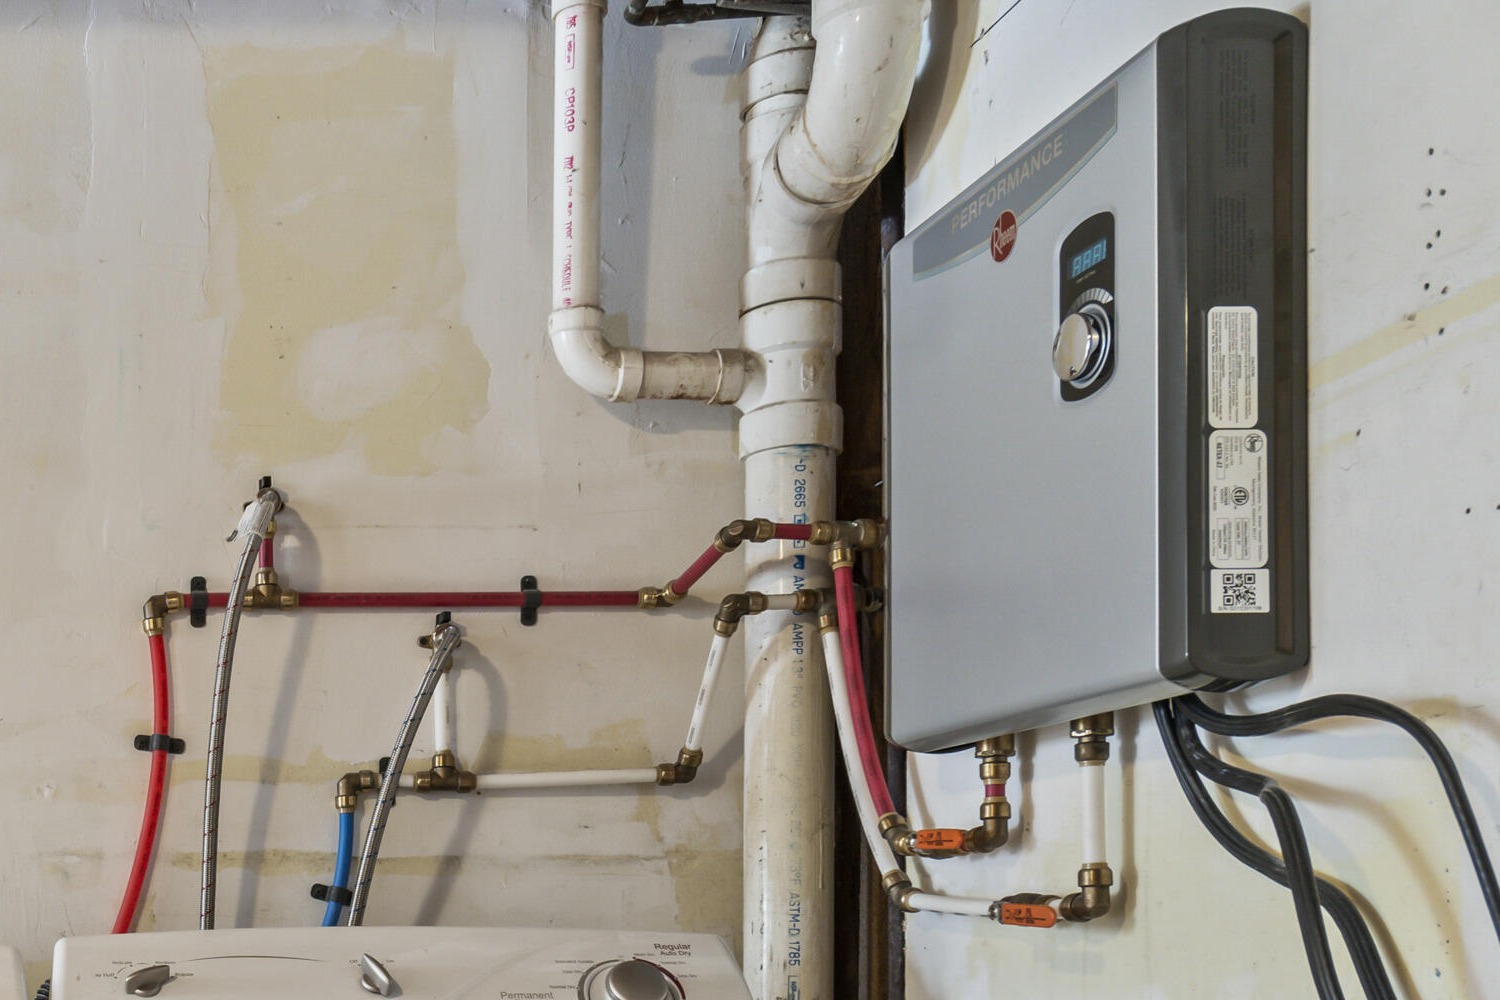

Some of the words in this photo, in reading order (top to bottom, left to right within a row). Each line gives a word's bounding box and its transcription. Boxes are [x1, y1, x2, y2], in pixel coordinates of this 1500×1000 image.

[951, 134, 1064, 237] PERFORMANCE
[993, 214, 1017, 257] Rheem
[794, 478, 807, 508] 2665
[792, 623, 805, 656] AMPP
[788, 892, 803, 938] ASTM-D
[654, 943, 692, 951] Regular
[788, 941, 802, 968] 1785
[500, 991, 554, 1000] Permanent
